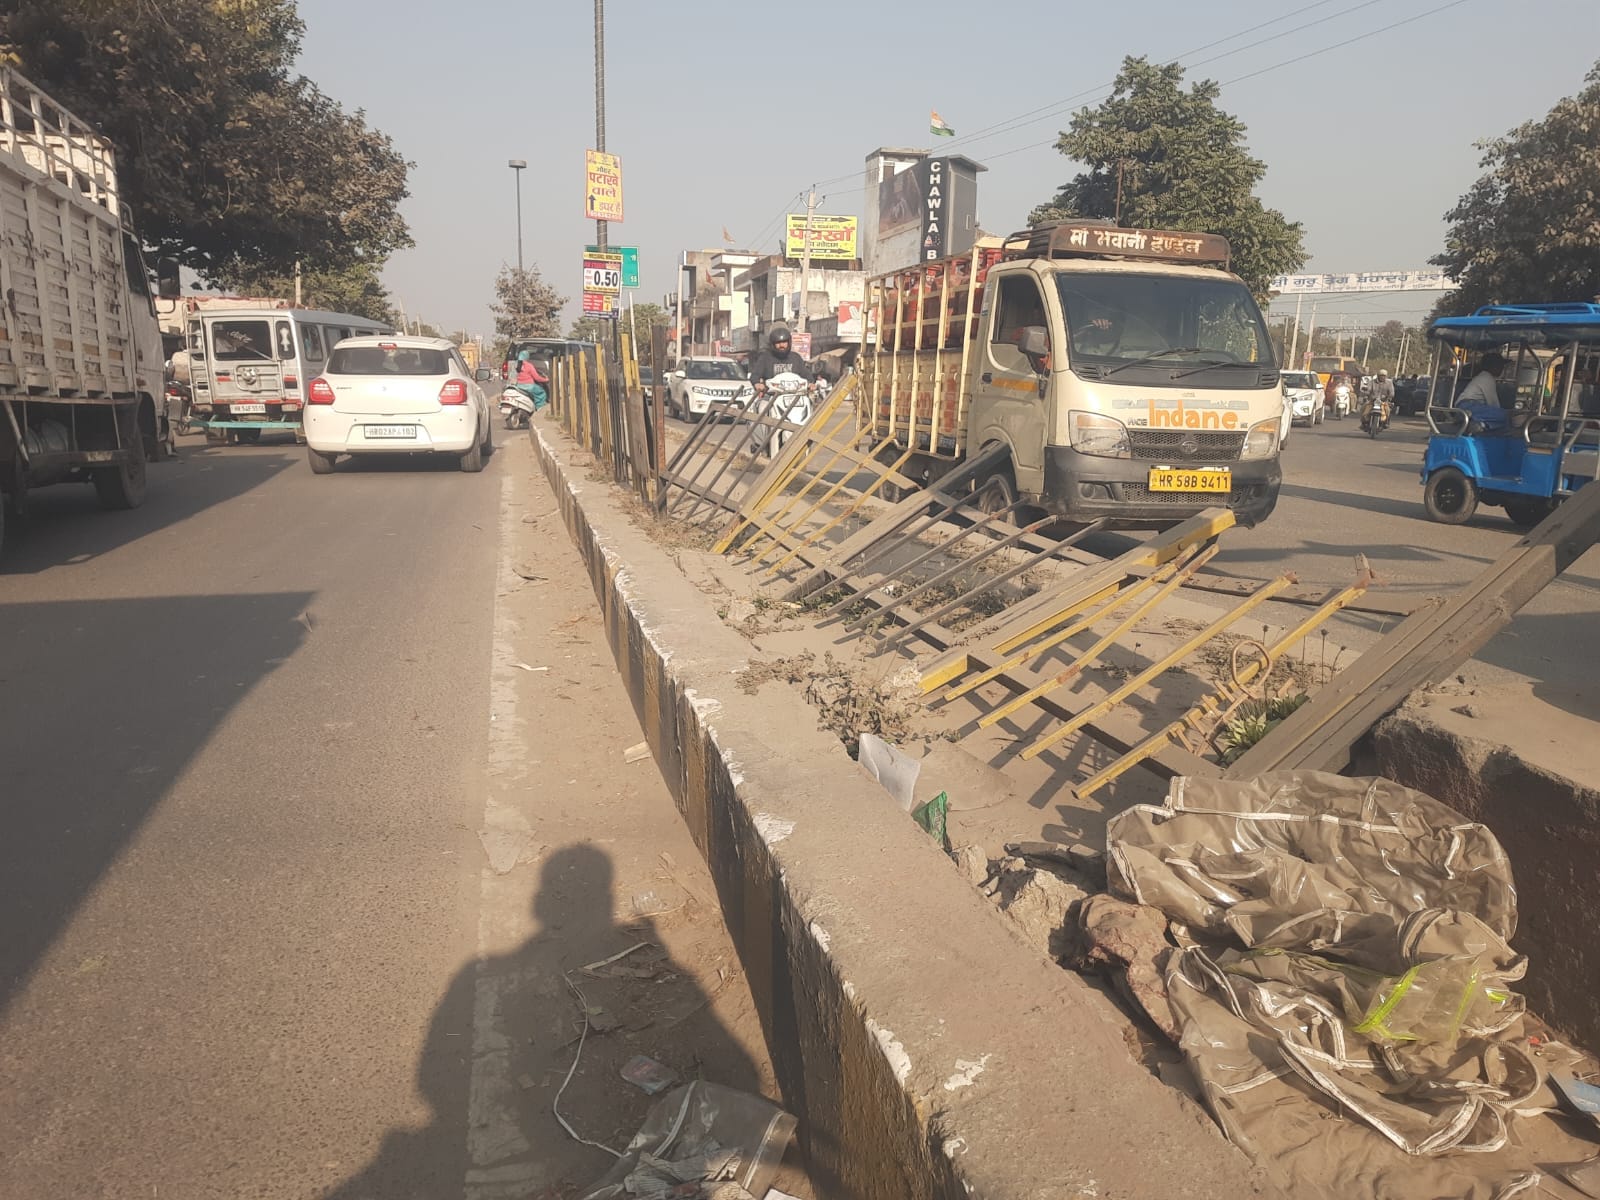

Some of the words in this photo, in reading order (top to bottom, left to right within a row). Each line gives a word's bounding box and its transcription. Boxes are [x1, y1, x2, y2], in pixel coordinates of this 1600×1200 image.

[927, 161, 942, 233] CHAWLA
[1094, 230, 1148, 250] भवानी
[594, 270, 619, 287] 0.50
[1149, 398, 1239, 429] Indane
[1159, 474, 1173, 488] HR
[1176, 475, 1198, 488] 58B
[1201, 476, 1228, 489] 9411
